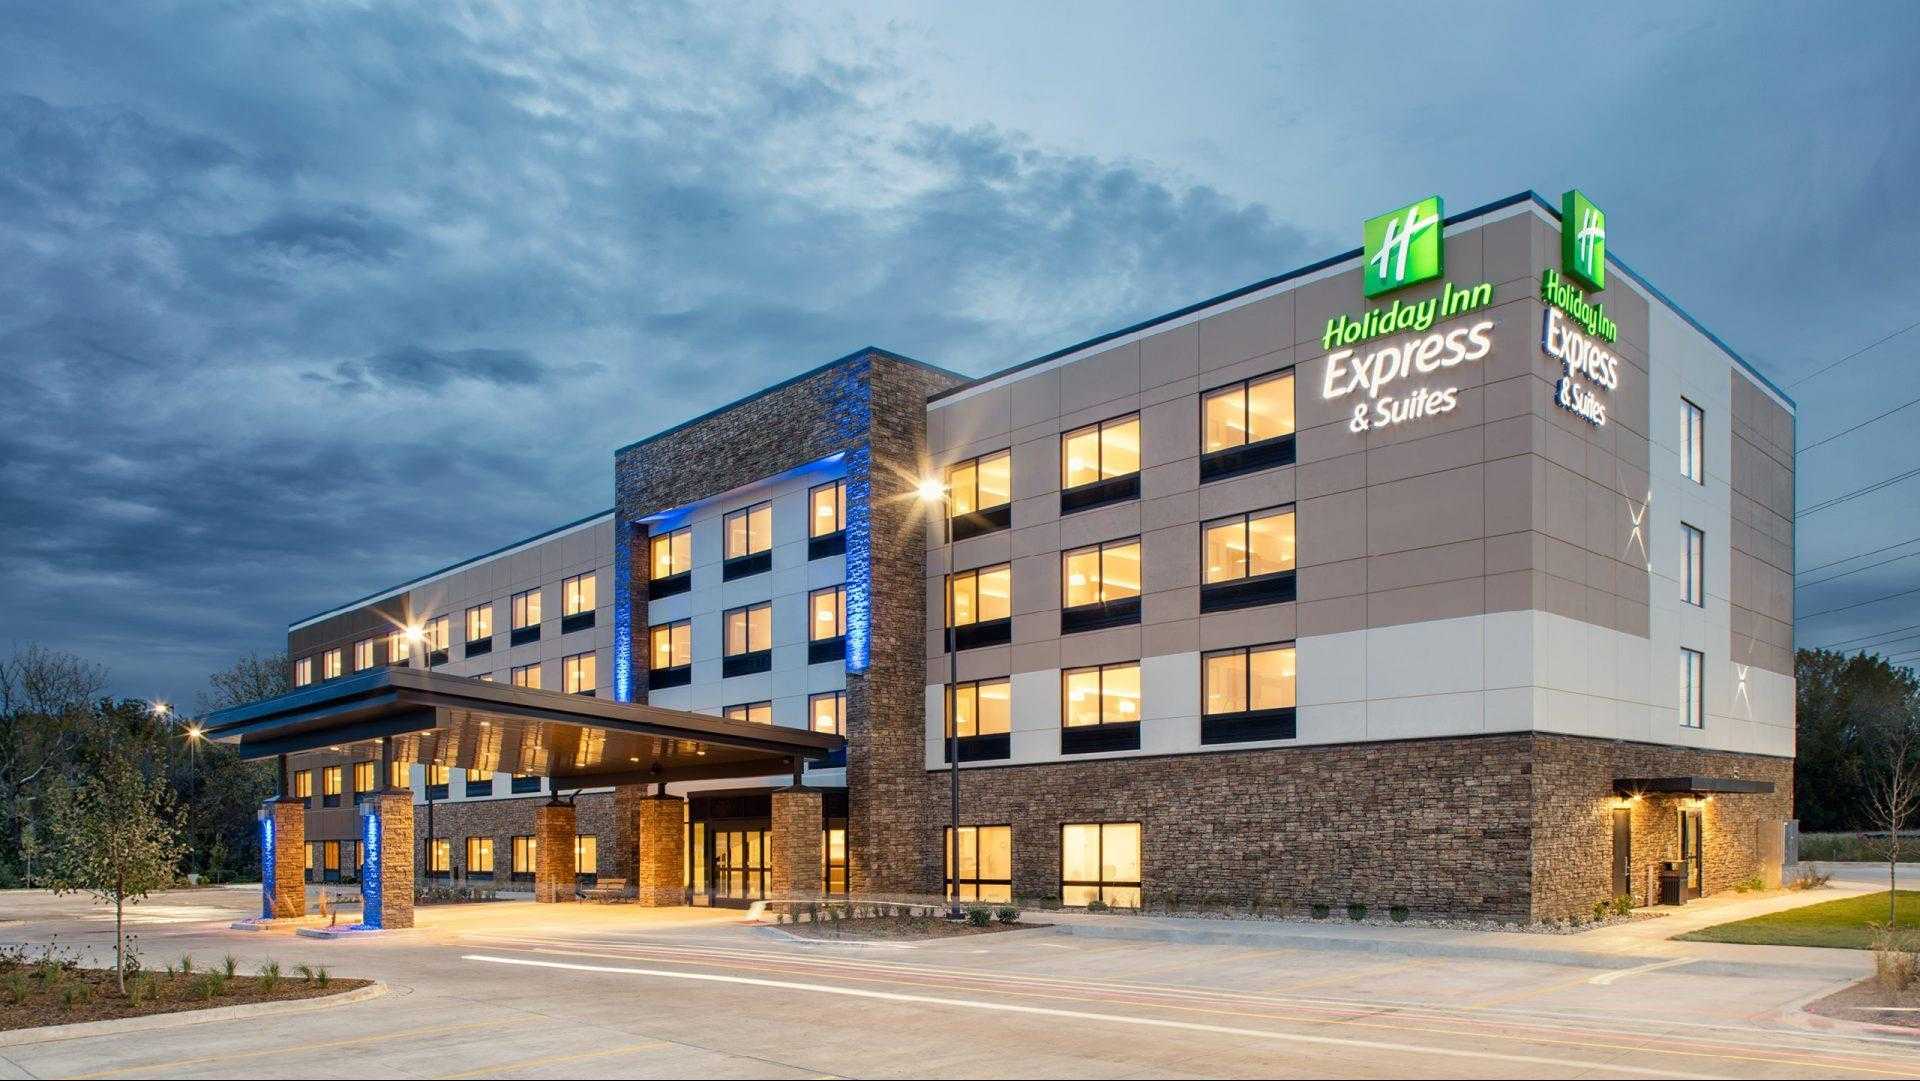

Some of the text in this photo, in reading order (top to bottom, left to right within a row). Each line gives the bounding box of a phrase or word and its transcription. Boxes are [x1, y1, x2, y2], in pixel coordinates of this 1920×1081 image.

[1323, 282, 1493, 349] Holiday Inn
[1545, 268, 1617, 343] Holiday Inn
[1322, 321, 1494, 399] Express
[1546, 307, 1618, 390] Express
[1350, 387, 1458, 433] & Suites
[1560, 376, 1606, 427] & Suites
